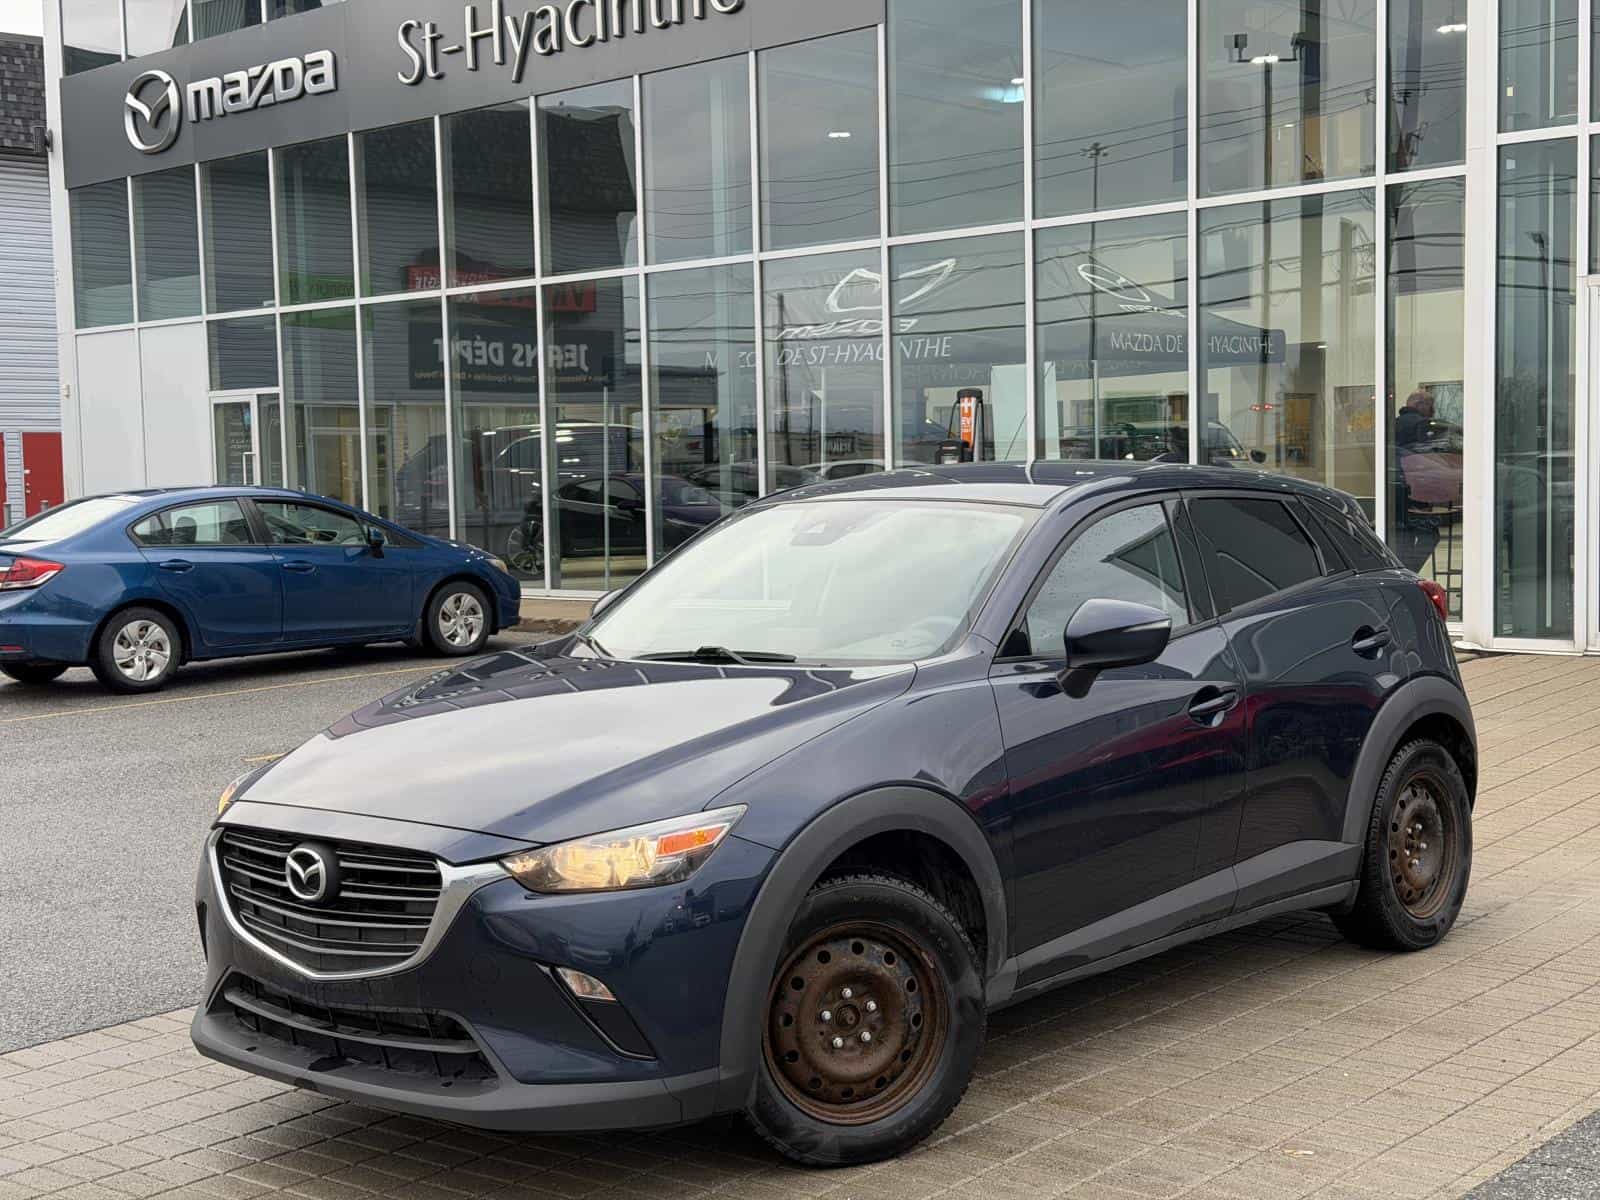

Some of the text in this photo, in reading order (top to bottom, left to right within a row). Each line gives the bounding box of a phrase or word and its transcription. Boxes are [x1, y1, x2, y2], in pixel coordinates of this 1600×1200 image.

[397, 0, 743, 84] St-Hyacin
[776, 347, 804, 367] DE
[806, 336, 953, 366] ST-HYACNTHE
[1110, 332, 1161, 352] MAZDA
[1166, 334, 1184, 353] DE
